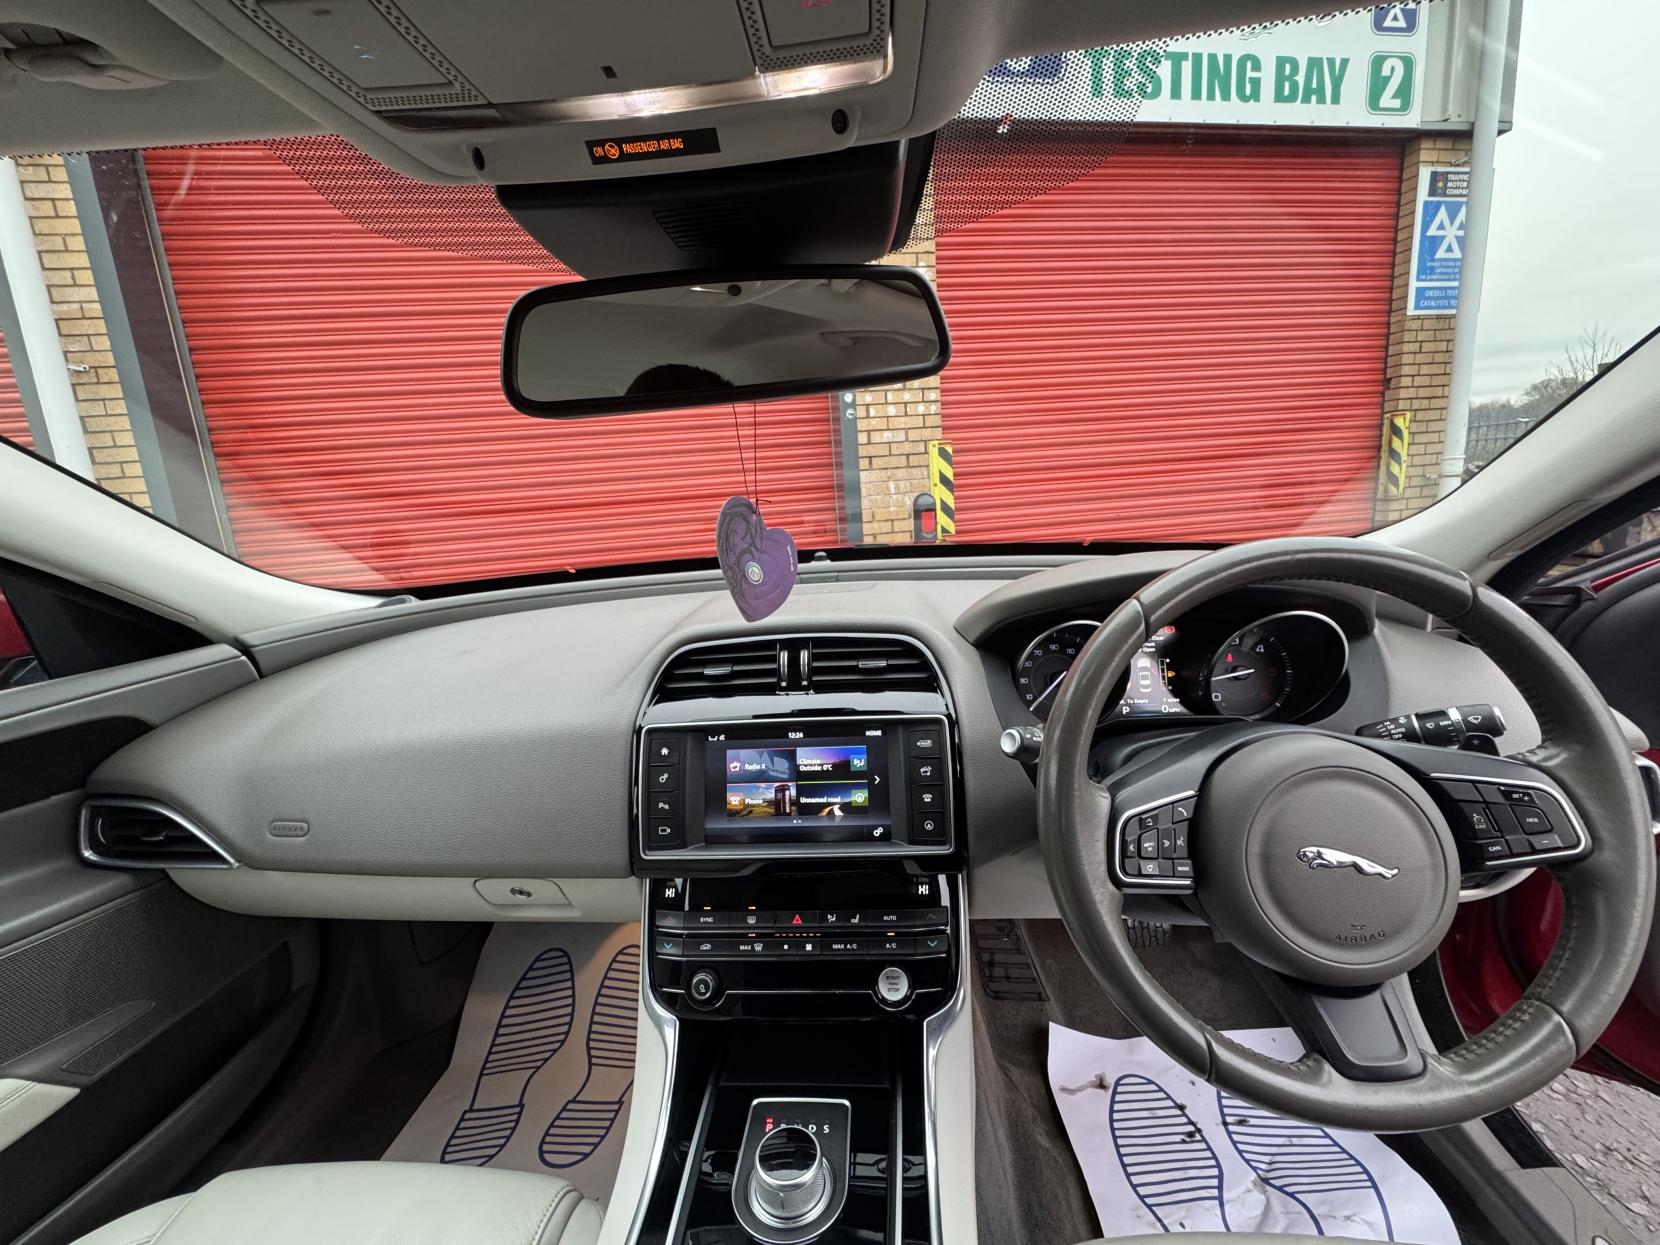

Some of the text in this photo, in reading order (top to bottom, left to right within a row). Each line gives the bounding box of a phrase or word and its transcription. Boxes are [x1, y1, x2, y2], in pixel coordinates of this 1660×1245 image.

[1085, 47, 1350, 105] TESTING BAY
[1379, 57, 1405, 109] 2
[593, 138, 684, 157] ON PASSENGER AIR BAG
[918, 885, 929, 895] HI
[1335, 930, 1385, 943] AIRBAG
[765, 1123, 774, 1132] P
[808, 1124, 817, 1133] D
[823, 1124, 830, 1133] S
